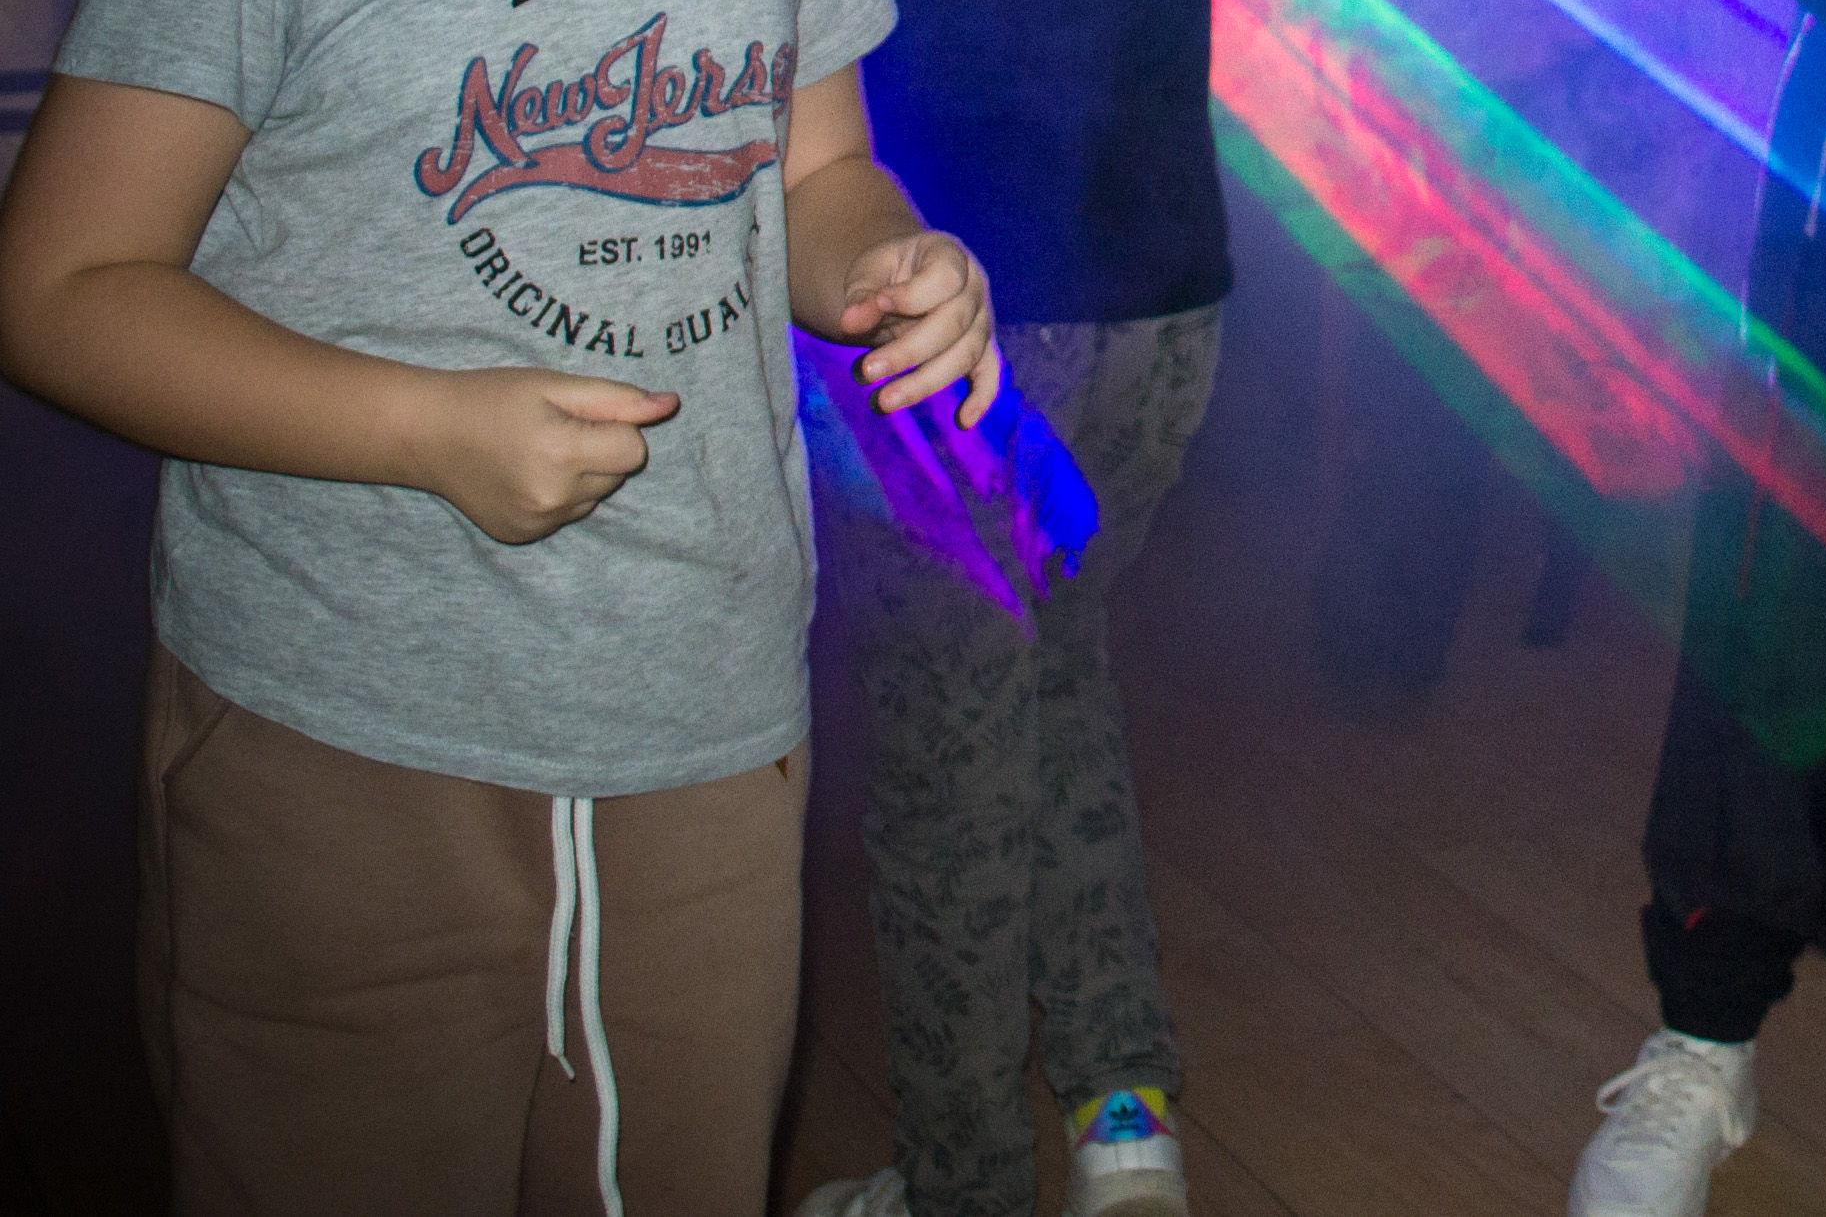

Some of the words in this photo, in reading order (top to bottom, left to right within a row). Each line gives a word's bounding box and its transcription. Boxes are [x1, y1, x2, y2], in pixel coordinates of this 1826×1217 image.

[414, 42, 600, 198] New
[579, 237, 643, 266] EST.
[654, 229, 712, 260] 1991
